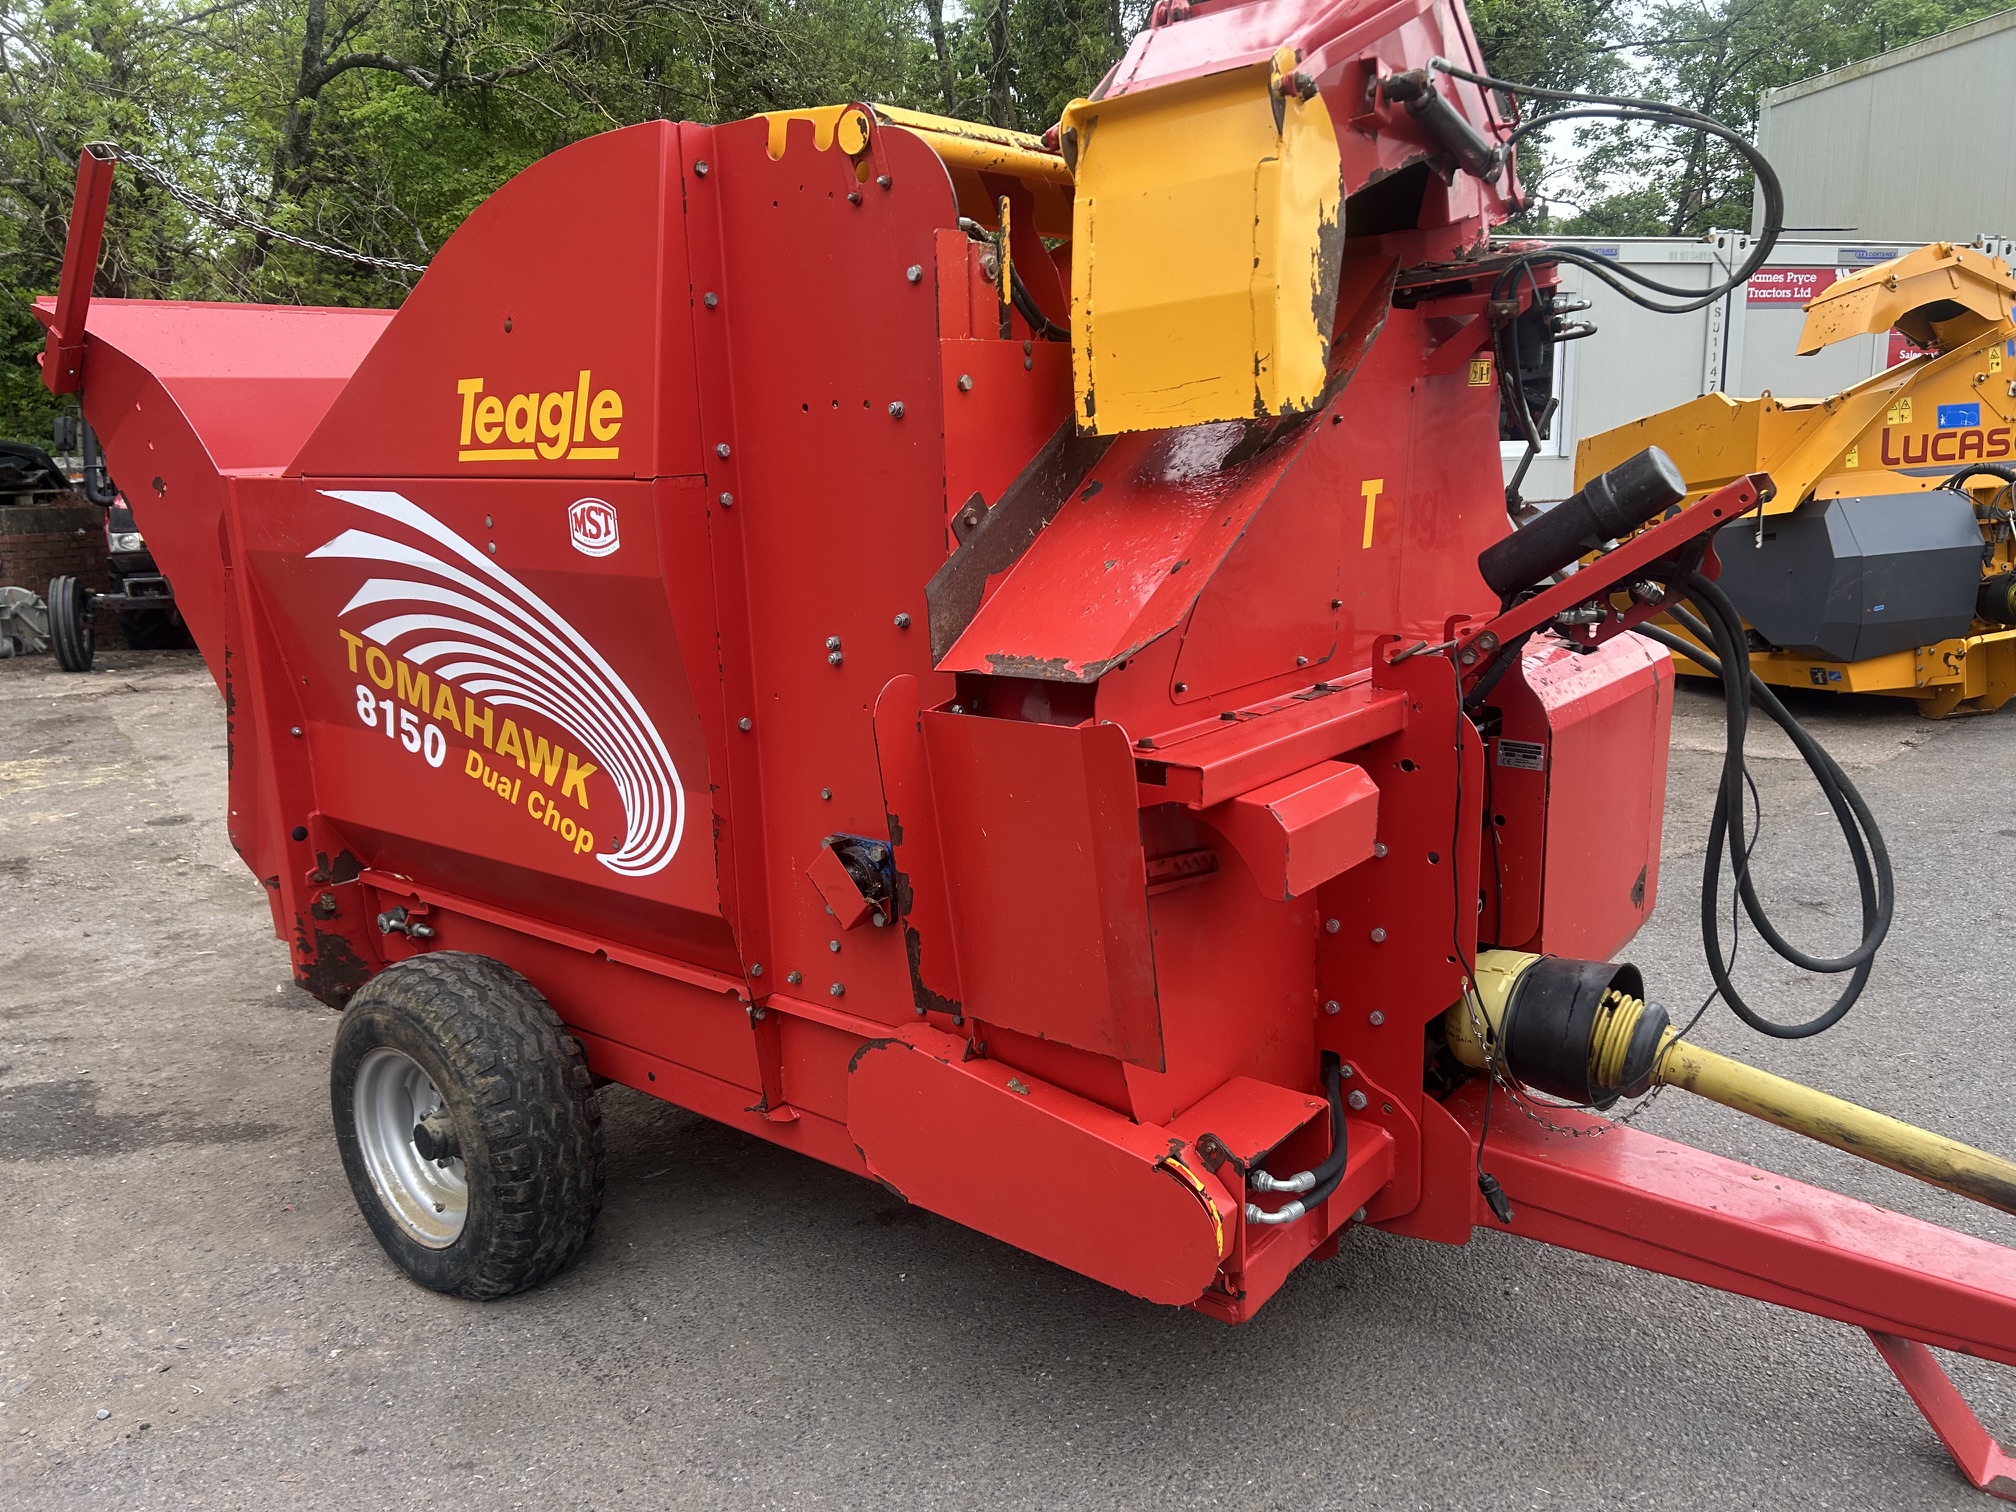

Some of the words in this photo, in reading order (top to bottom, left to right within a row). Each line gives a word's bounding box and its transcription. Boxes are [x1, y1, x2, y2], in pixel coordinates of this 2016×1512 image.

[1748, 287, 1792, 298] Tractors
[1793, 287, 1812, 298] Ltd
[1749, 273, 1784, 283] James
[1786, 272, 1817, 285] Pryce
[457, 369, 624, 460] Teagle
[1880, 427, 2012, 466] LUCAS
[572, 505, 613, 540] MST
[339, 628, 599, 811] TOMAHAWK
[356, 684, 447, 769] 8150
[464, 748, 522, 805] Dual
[527, 790, 595, 855] Chop
